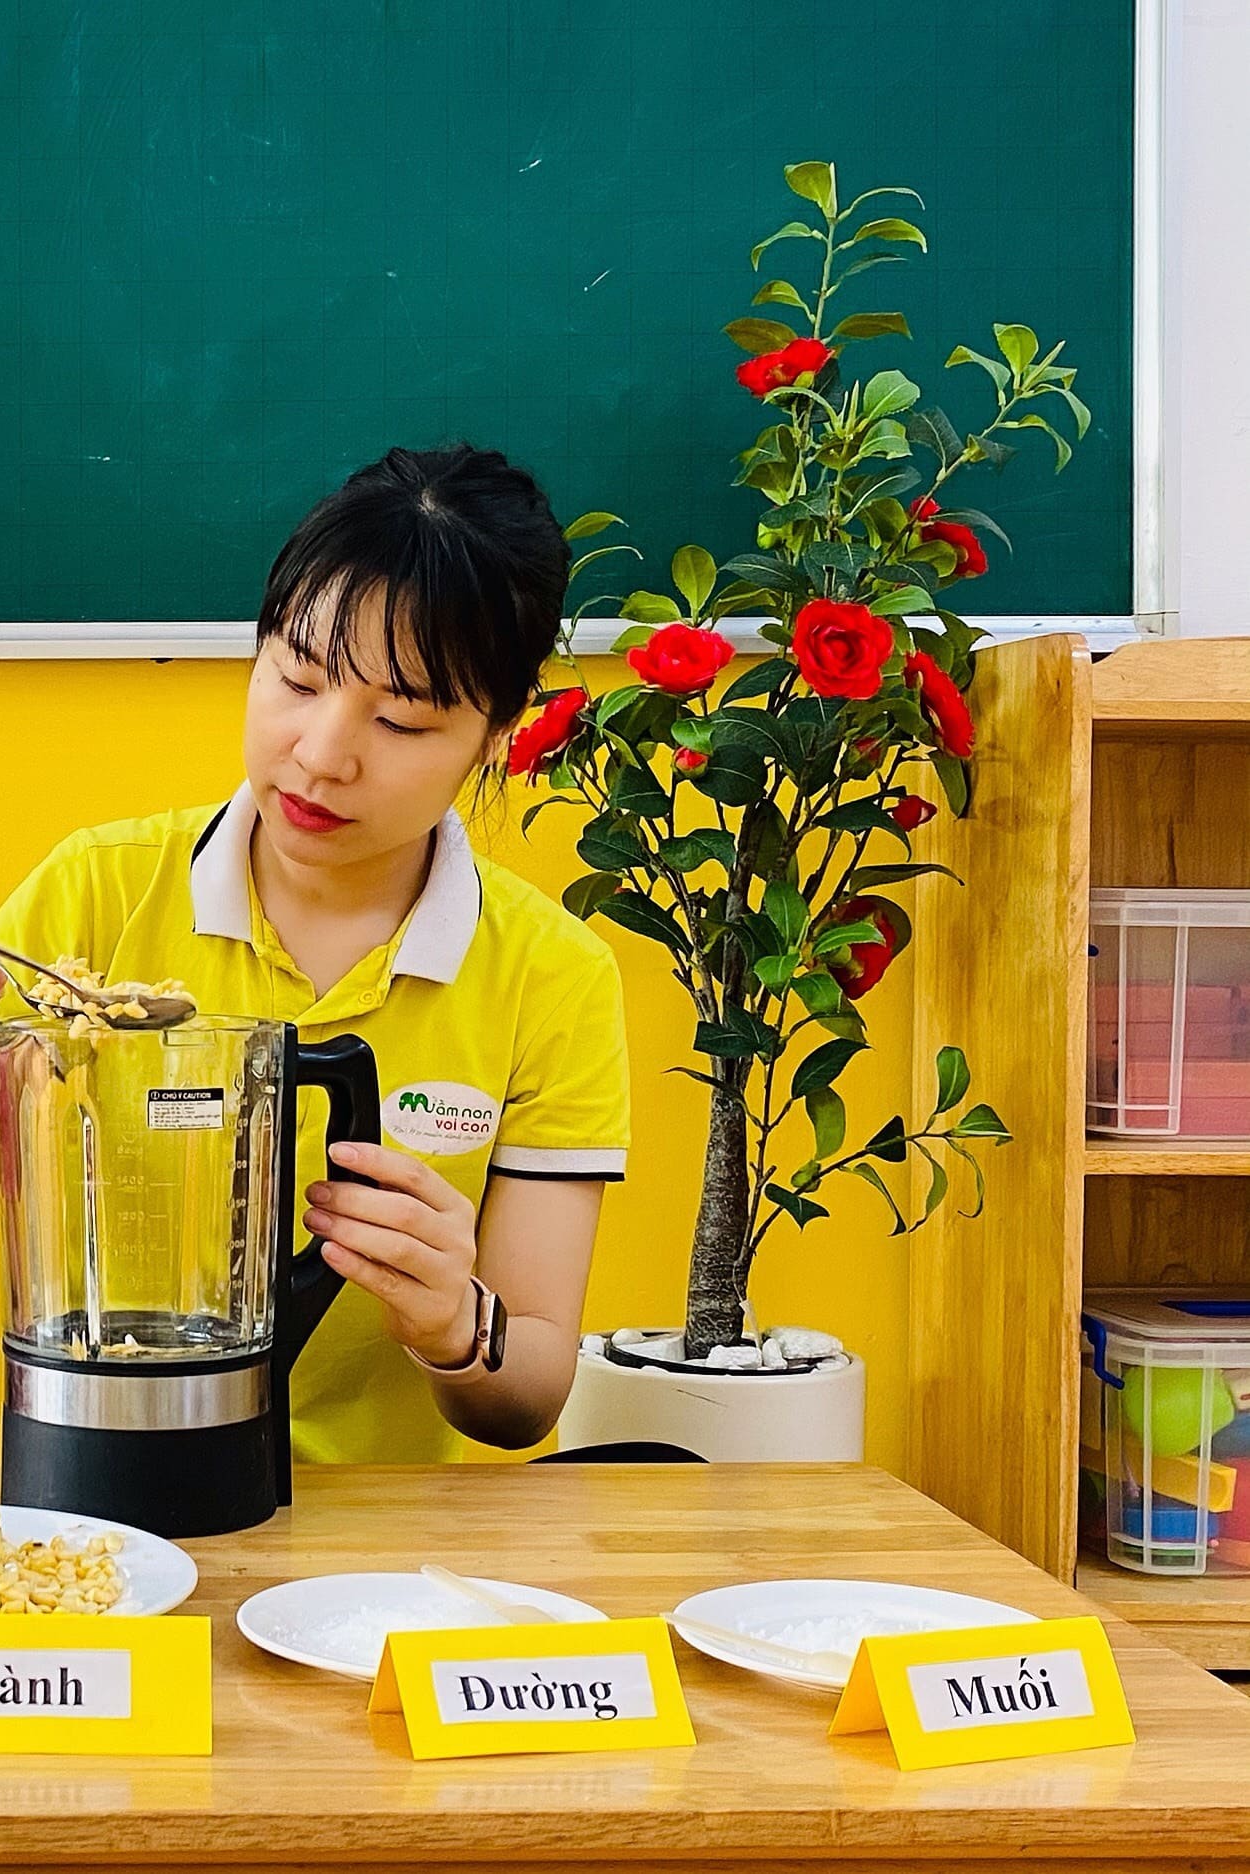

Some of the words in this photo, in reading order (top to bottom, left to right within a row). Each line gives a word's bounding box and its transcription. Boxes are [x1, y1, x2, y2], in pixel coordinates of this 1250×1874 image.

[436, 1118, 457, 1130] voi
[461, 1121, 489, 1132] con
[461, 1108, 492, 1119] non
[455, 1671, 618, 1721] Đường
[943, 1657, 1060, 1718] Muối
